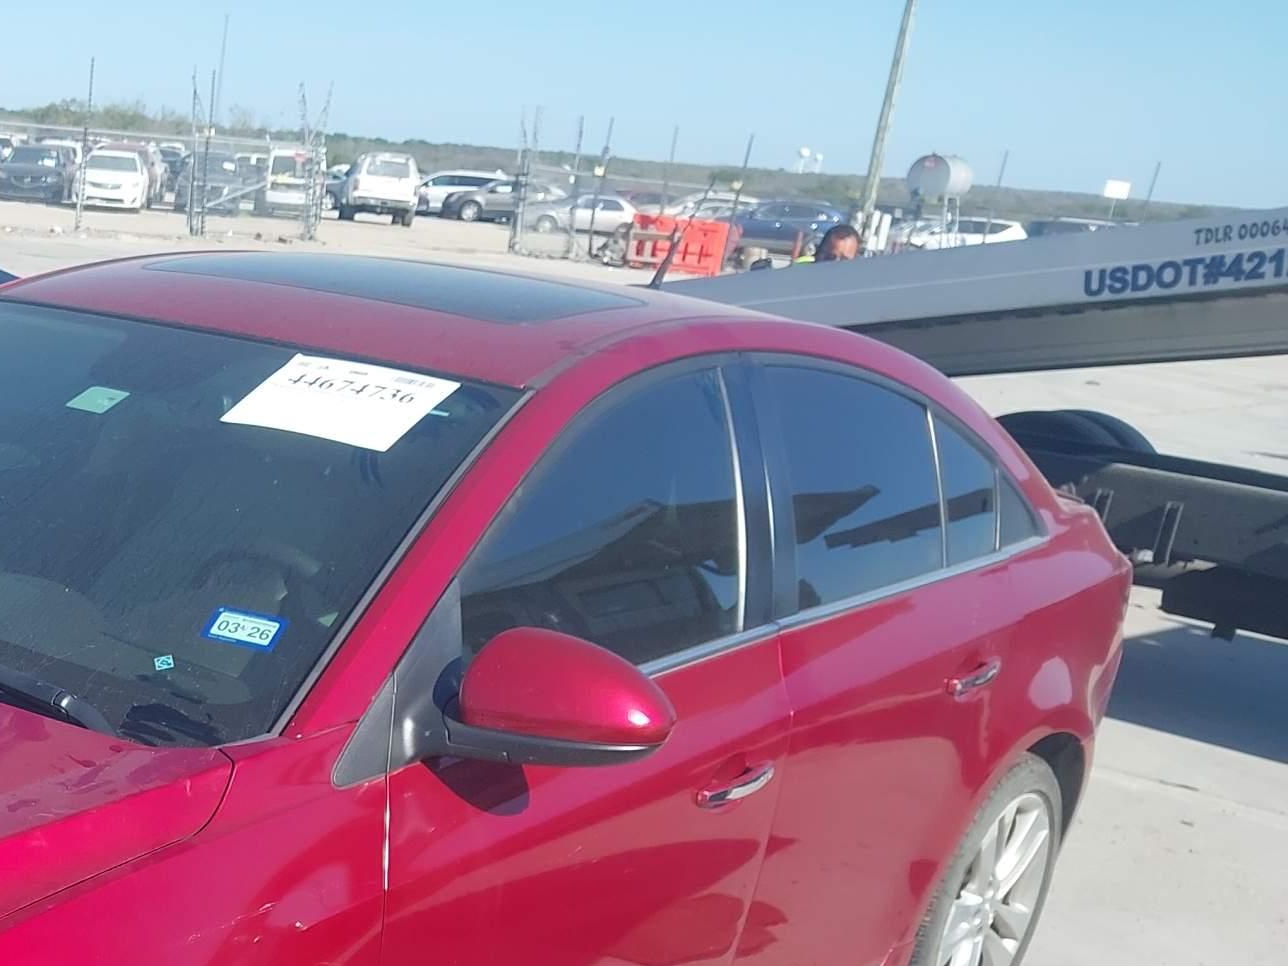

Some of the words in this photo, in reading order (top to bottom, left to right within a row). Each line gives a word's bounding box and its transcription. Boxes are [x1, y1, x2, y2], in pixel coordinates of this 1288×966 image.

[1194, 225, 1233, 246] TDLR
[1083, 247, 1288, 297] USDOT#421
[288, 373, 415, 403] 44674736
[217, 620, 241, 634] 03
[247, 626, 272, 641] 26
